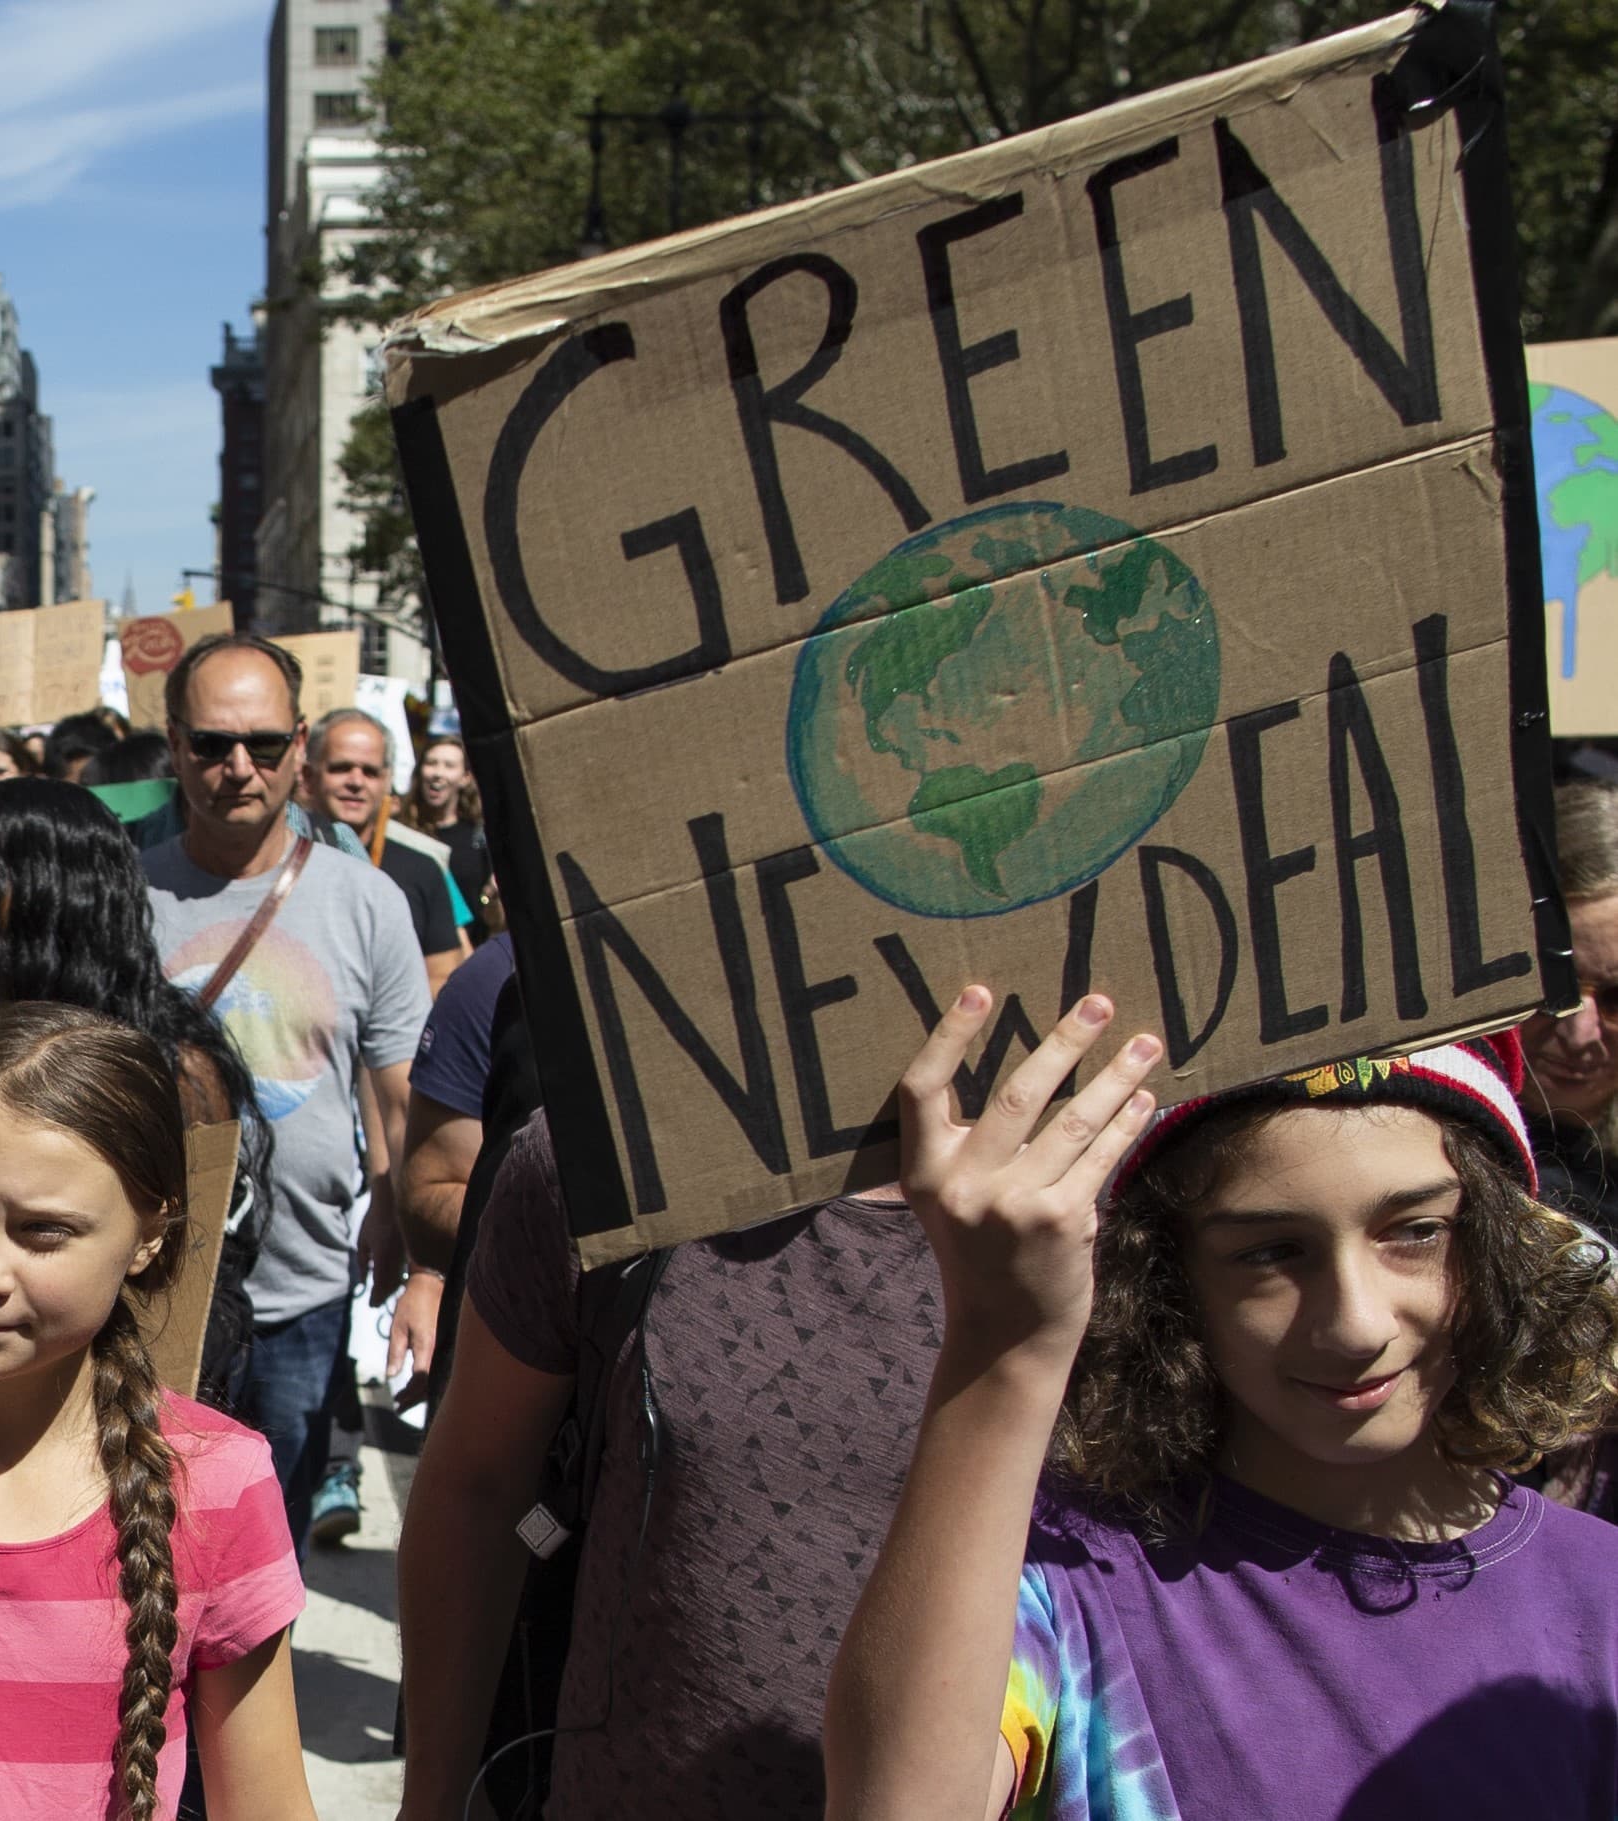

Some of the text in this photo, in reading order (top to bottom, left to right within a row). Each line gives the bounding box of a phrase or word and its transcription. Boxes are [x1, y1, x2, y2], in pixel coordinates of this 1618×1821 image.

[483, 73, 1442, 700] GREEN
[557, 613, 1532, 1214] NEW DEAL
